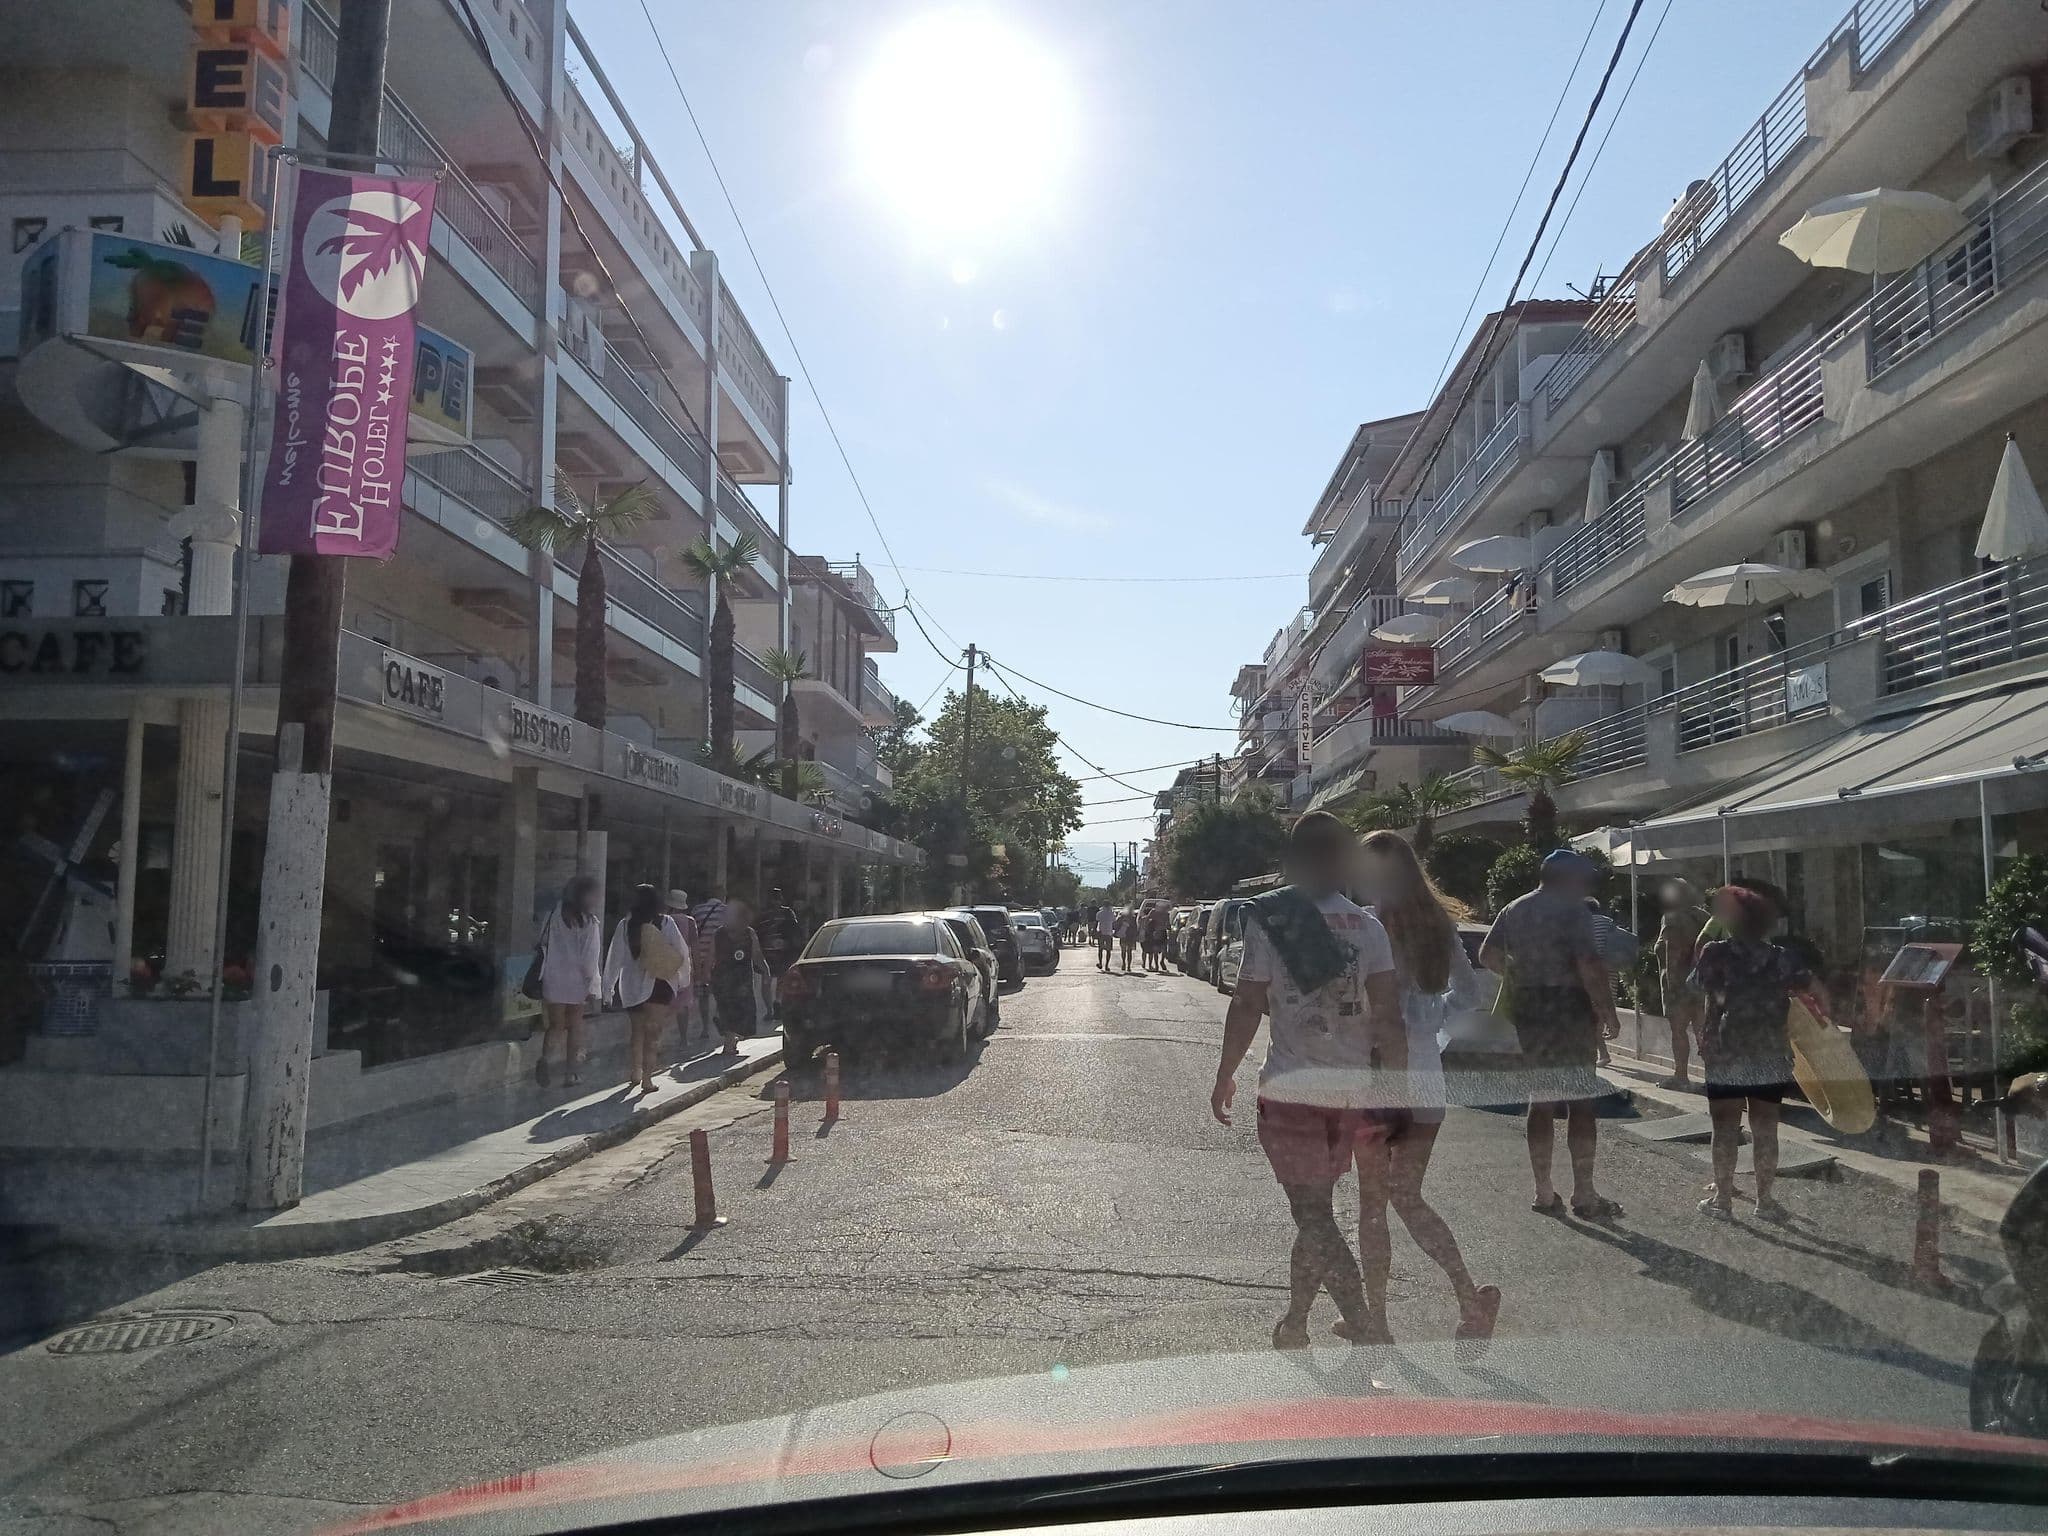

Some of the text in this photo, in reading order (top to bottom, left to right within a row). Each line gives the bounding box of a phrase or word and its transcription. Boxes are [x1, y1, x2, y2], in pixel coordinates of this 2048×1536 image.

[0, 631, 146, 673] CAFE
[385, 660, 444, 713] CAFE
[511, 707, 573, 754] BISTRO
[1301, 692, 1310, 761] CARAVEL
